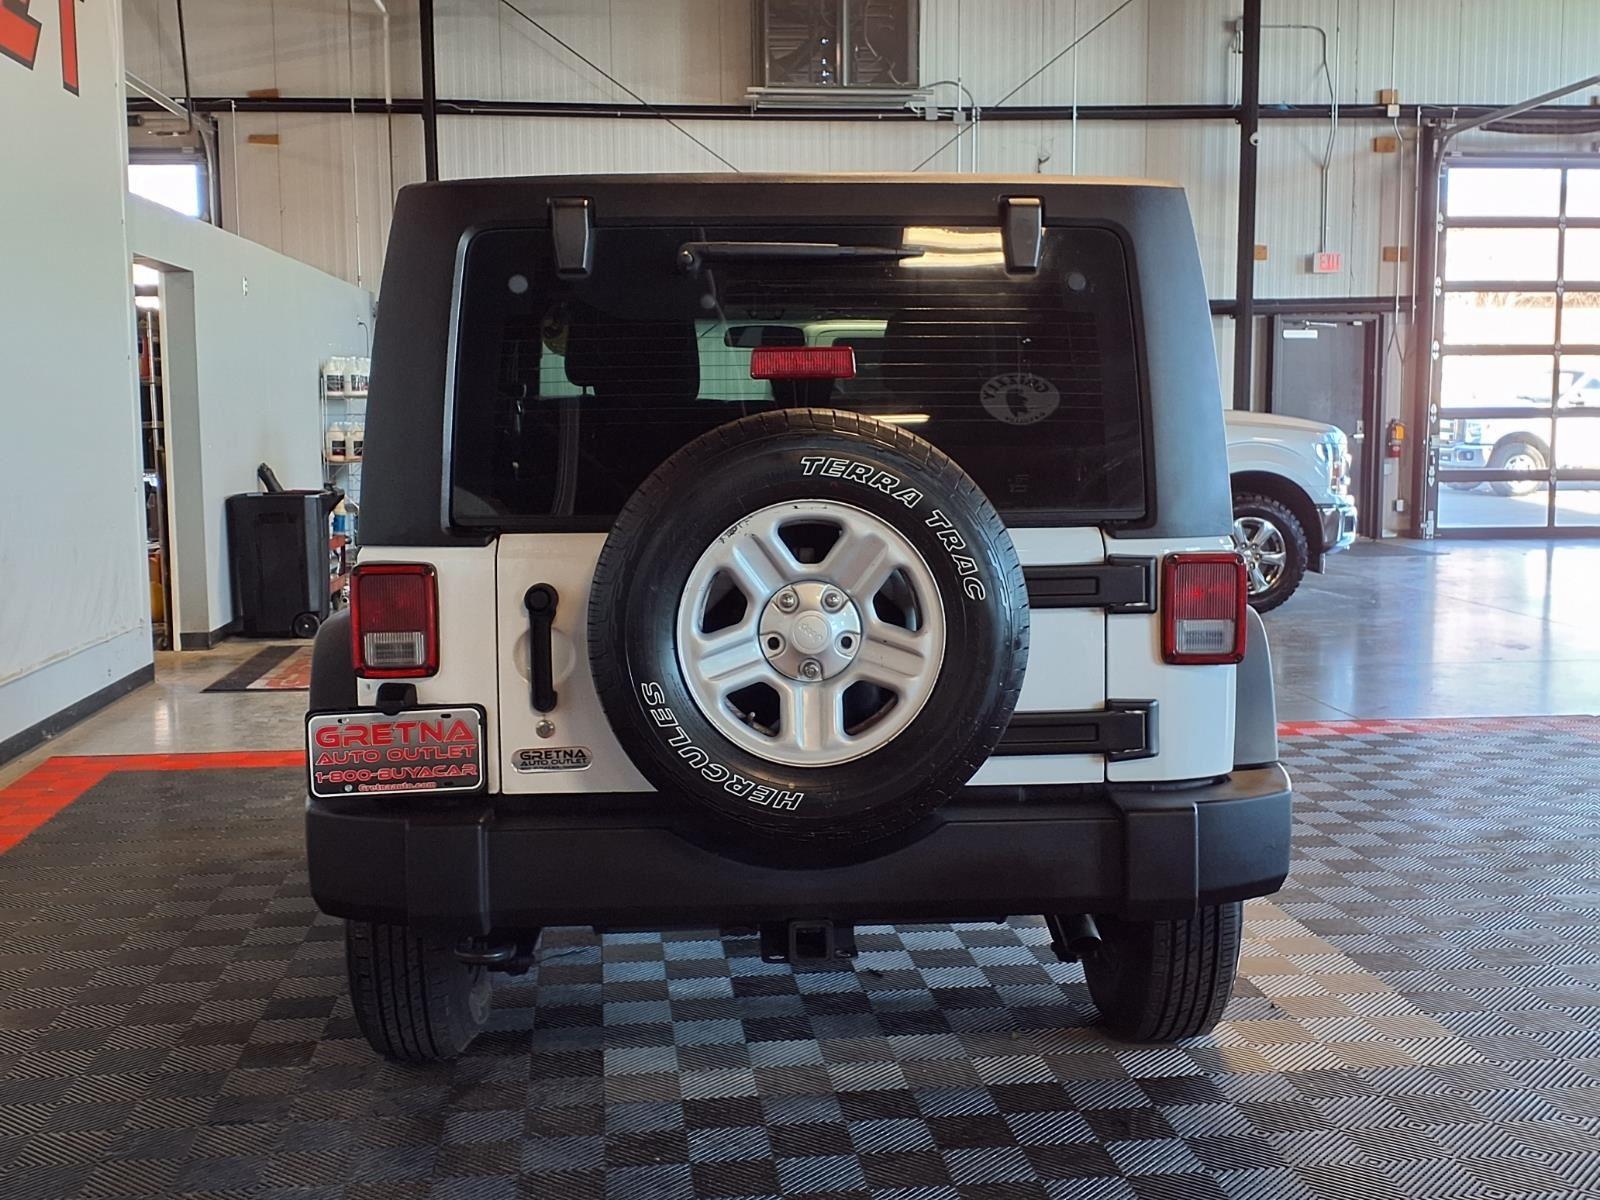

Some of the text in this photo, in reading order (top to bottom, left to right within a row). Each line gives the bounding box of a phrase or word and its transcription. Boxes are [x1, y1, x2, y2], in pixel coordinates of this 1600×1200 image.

[1319, 254, 1341, 270] EXIT
[800, 455, 985, 601] TERRA TRAC
[315, 719, 475, 748] GRETNA
[315, 745, 477, 766] AUTO OUTLET
[519, 749, 586, 761] GRETNA
[641, 681, 803, 811] HERCULES
[315, 763, 478, 783] 1-800-BUYACAR
[520, 759, 549, 767] AUTO
